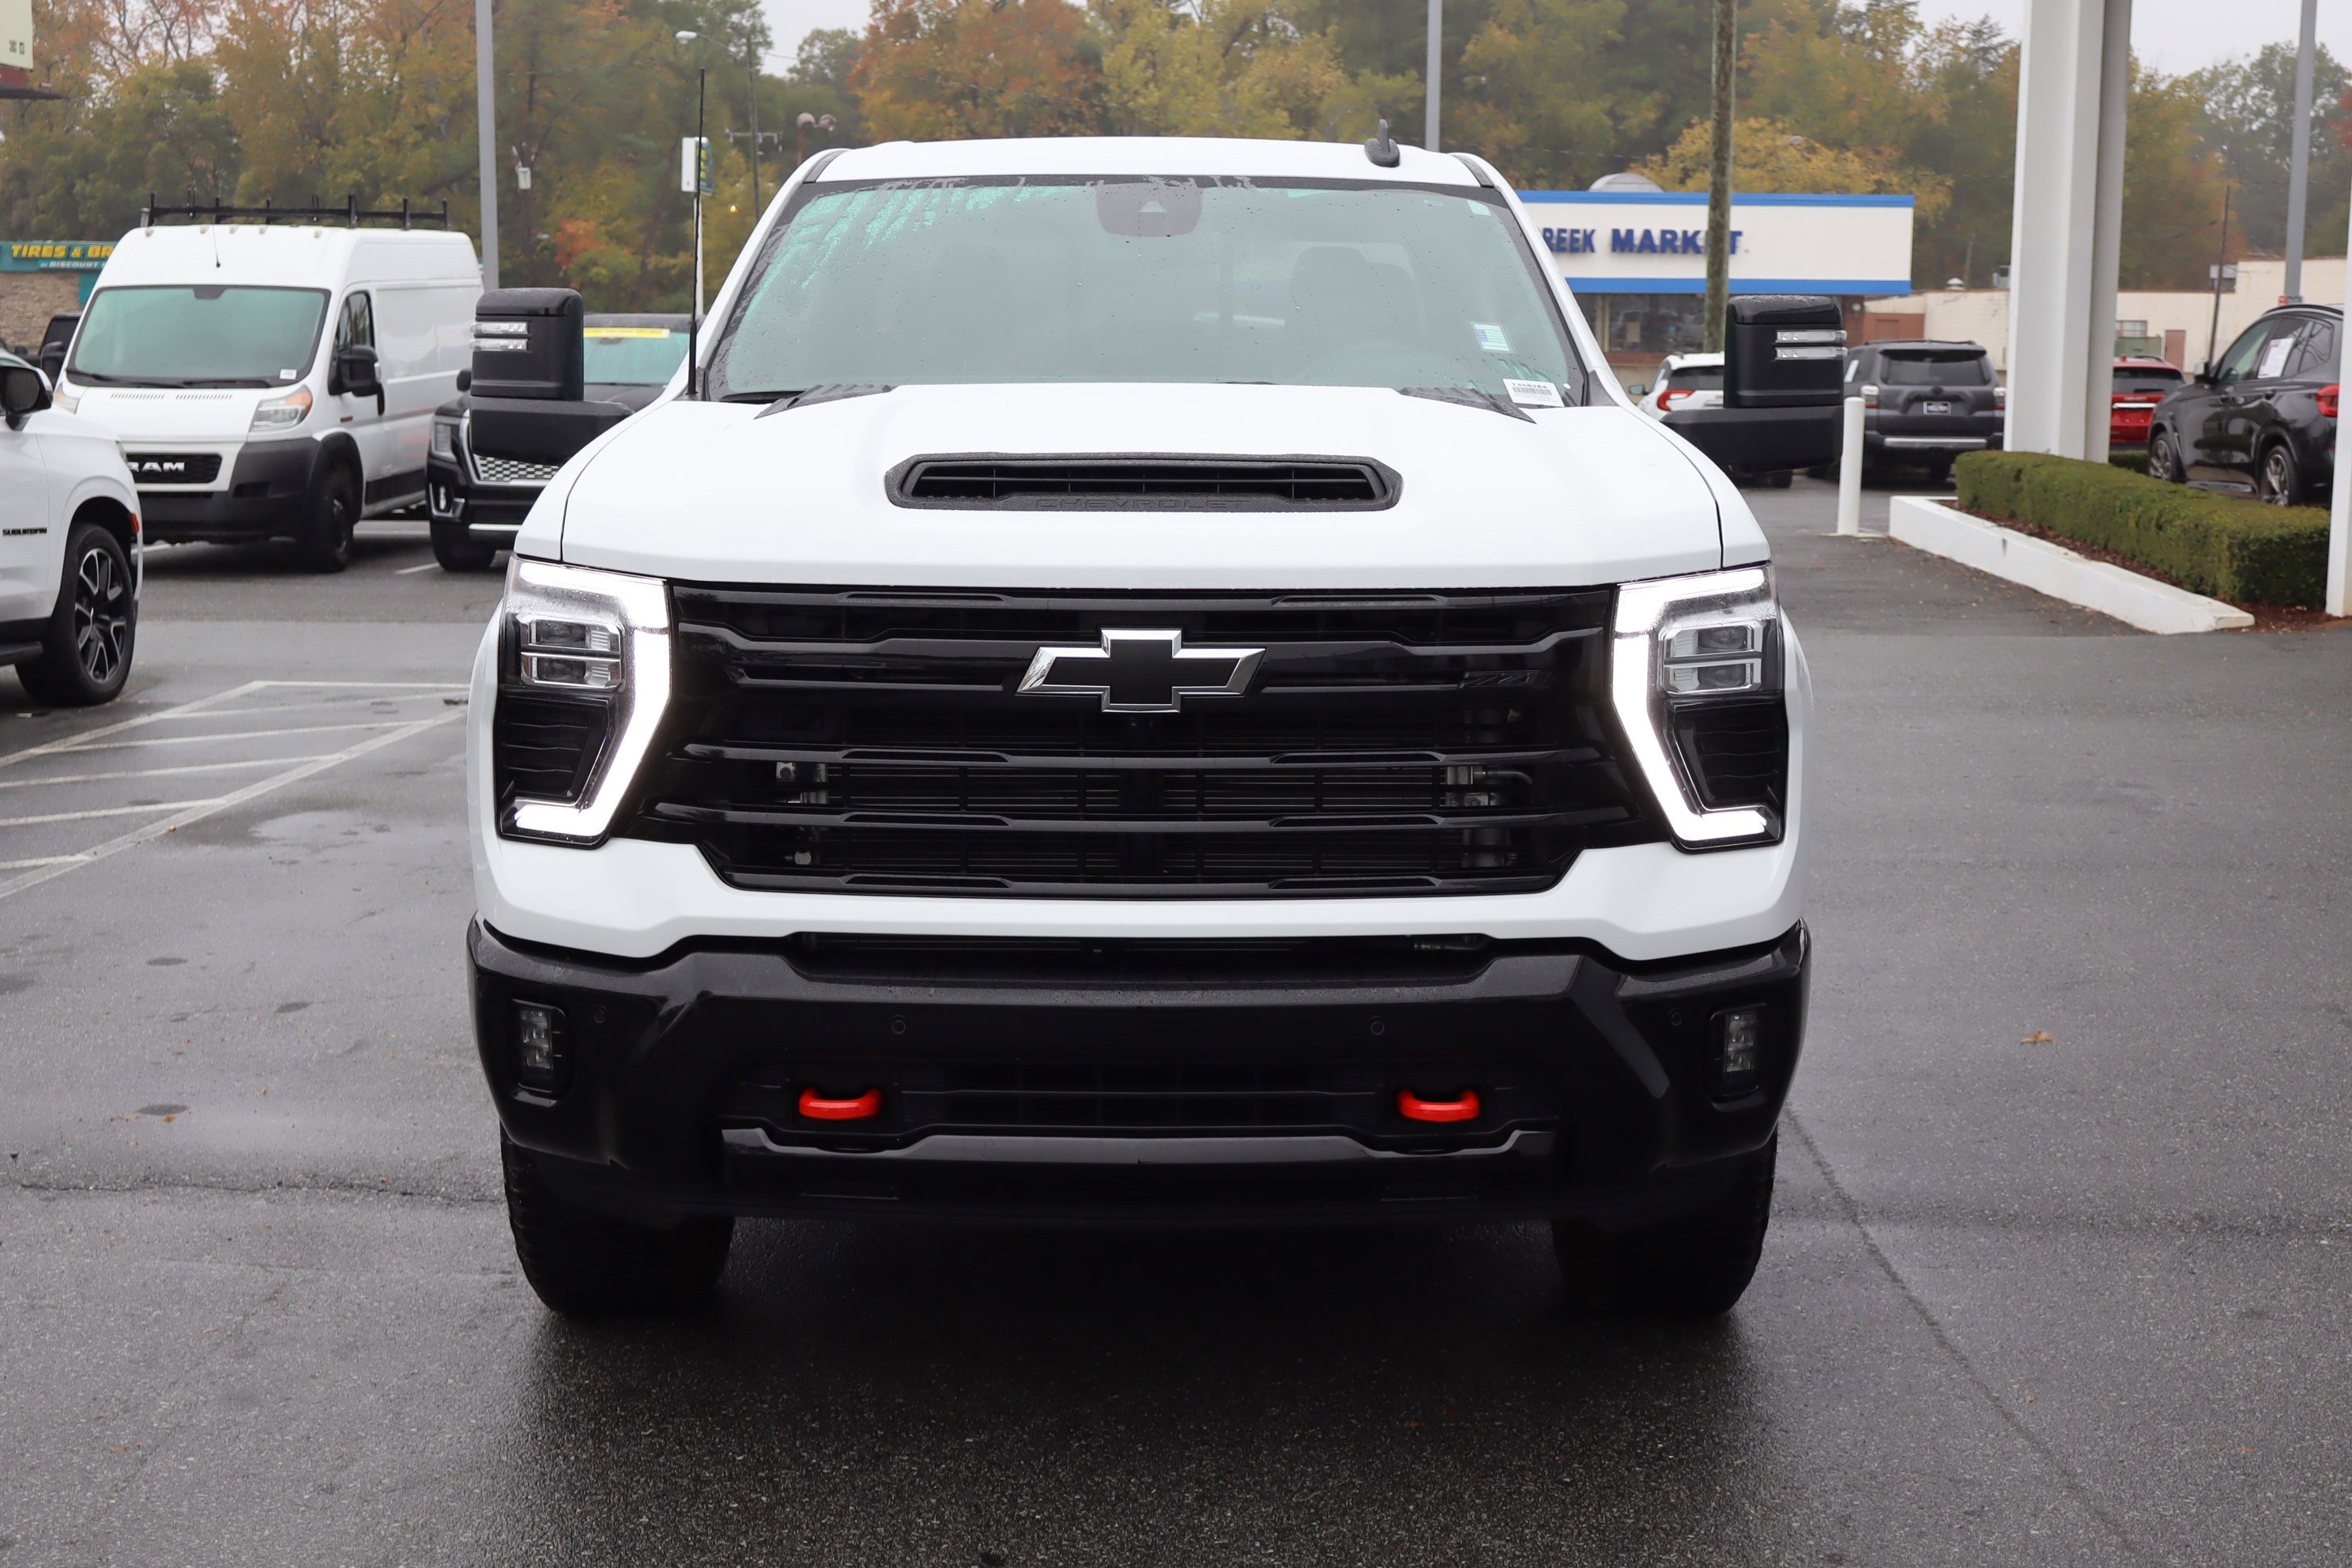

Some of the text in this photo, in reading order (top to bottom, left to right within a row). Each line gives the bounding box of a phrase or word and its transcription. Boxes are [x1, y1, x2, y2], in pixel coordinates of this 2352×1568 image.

[1543, 227, 1743, 255] REEK MARKT
[11, 244, 67, 258] TIRES
[70, 246, 82, 258] &
[126, 462, 185, 473] RAM
[1036, 498, 1250, 509] CHEVROLET
[1460, 670, 1540, 689] Z71
